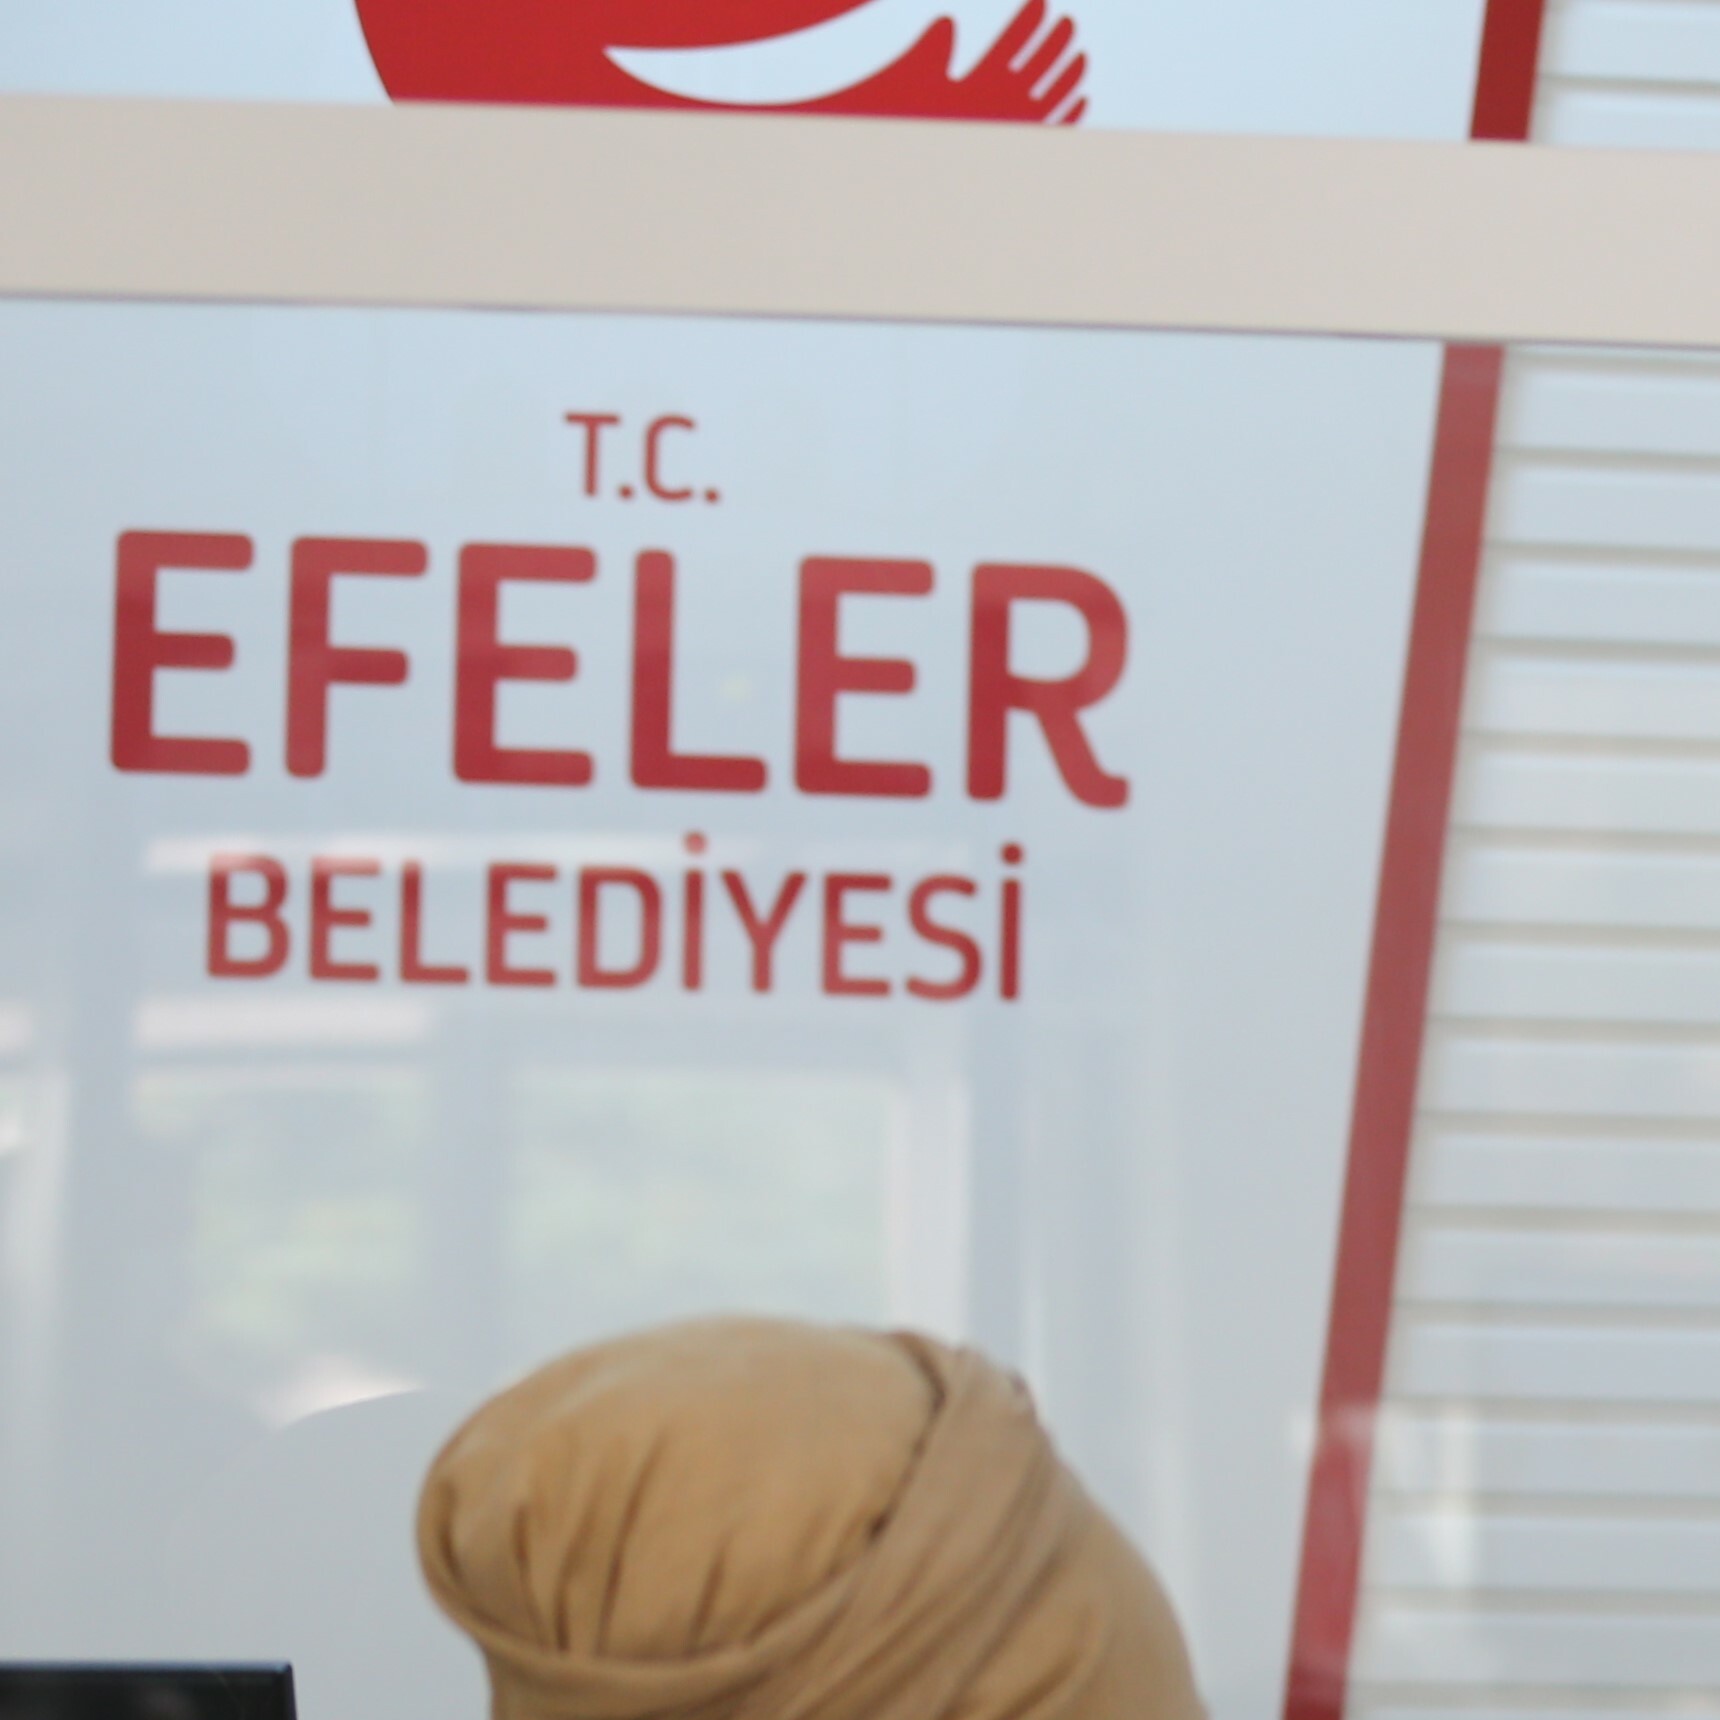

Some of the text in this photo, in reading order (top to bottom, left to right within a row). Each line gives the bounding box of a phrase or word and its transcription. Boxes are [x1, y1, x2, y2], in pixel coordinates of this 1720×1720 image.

[566, 412, 720, 504] T.C.
[108, 529, 1131, 811] EFELER
[206, 832, 1025, 1003] BELEDİYESİ
